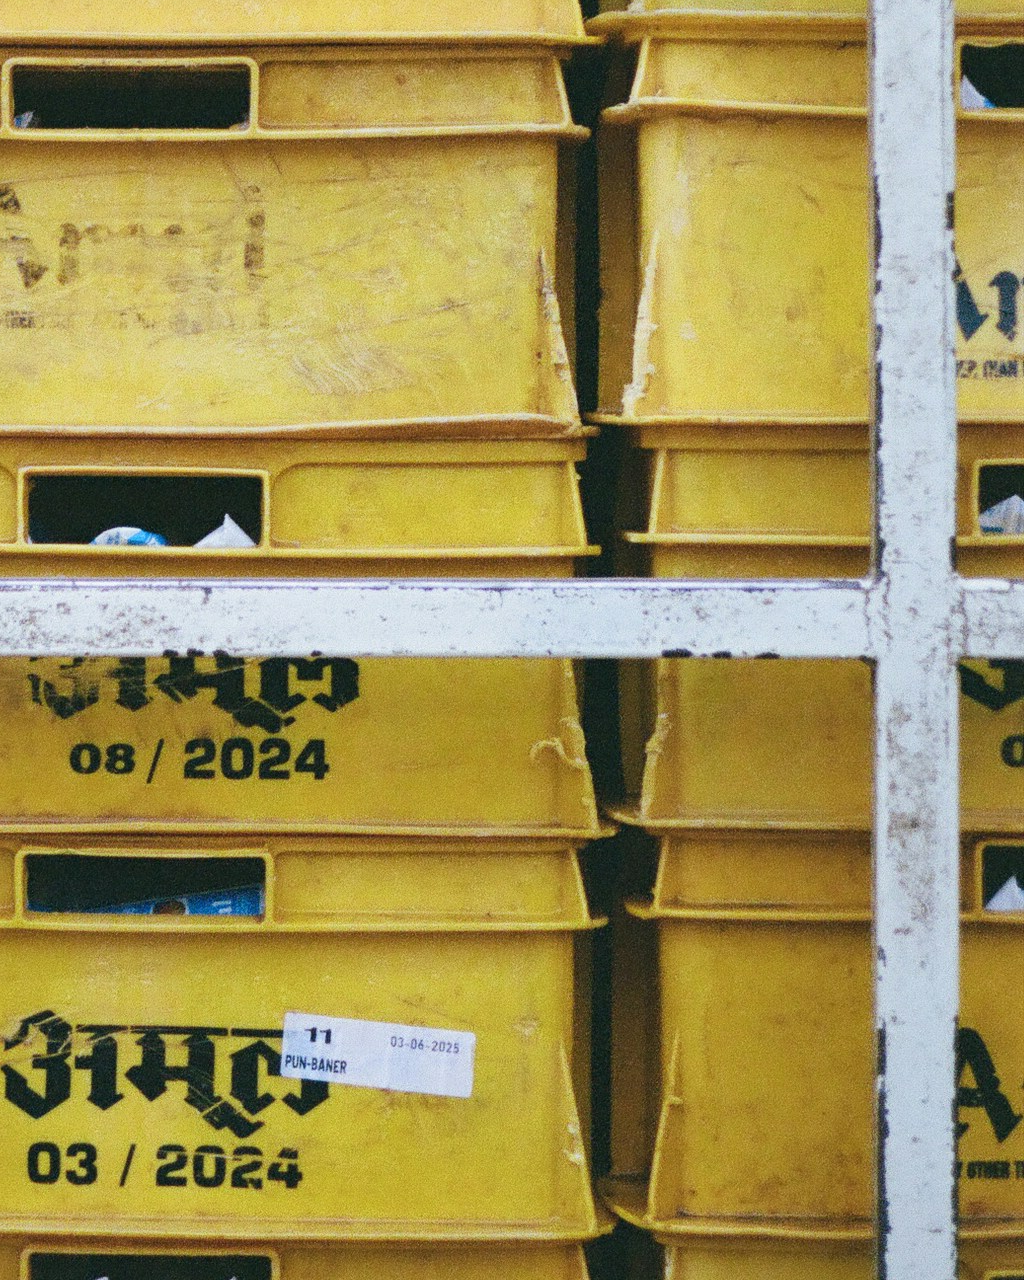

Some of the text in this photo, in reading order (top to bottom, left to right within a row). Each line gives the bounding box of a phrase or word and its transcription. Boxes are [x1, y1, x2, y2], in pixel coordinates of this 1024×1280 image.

[304, 1026, 460, 1055] 11 03-06-2025
[285, 1054, 348, 1075] PUN-BANER
